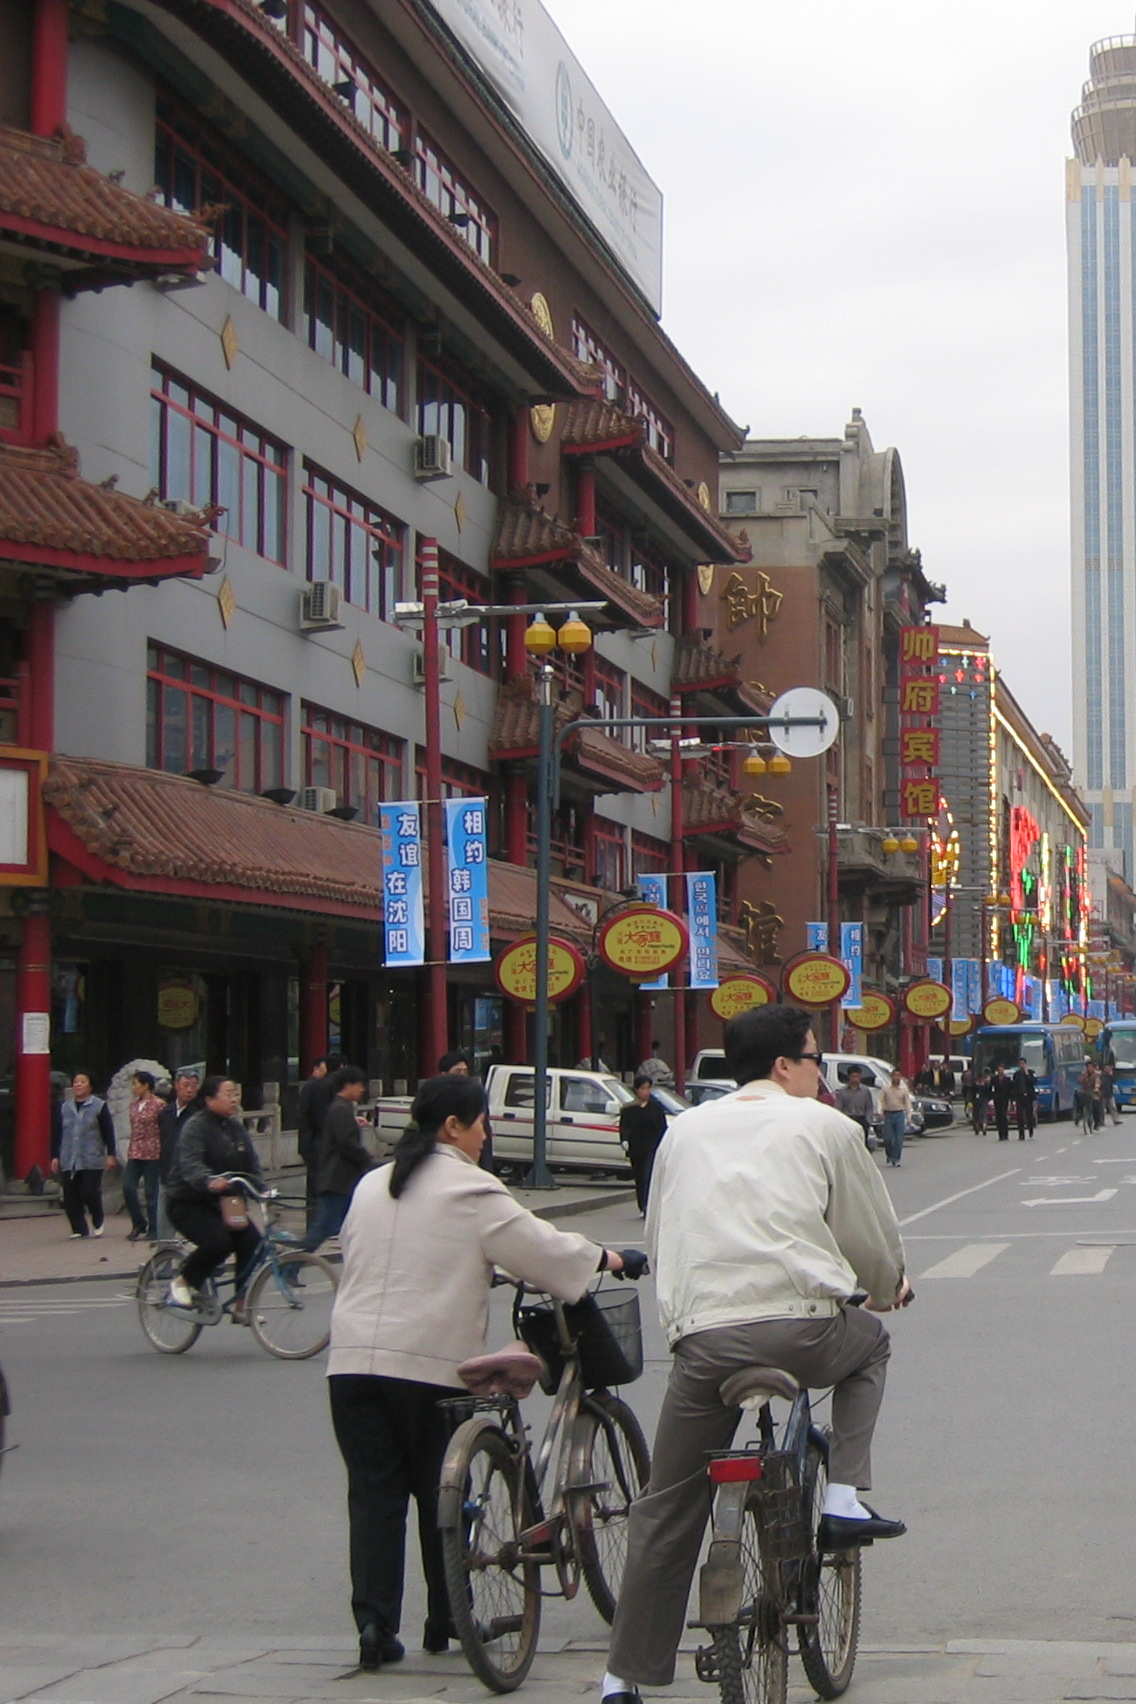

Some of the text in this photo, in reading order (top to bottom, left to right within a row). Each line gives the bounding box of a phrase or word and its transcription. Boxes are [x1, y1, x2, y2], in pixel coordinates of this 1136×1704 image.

[902, 629, 936, 815] 帅府宾馆
[386, 813, 419, 954] 友谊在沈阳
[451, 810, 484, 952] 相约韩国周
